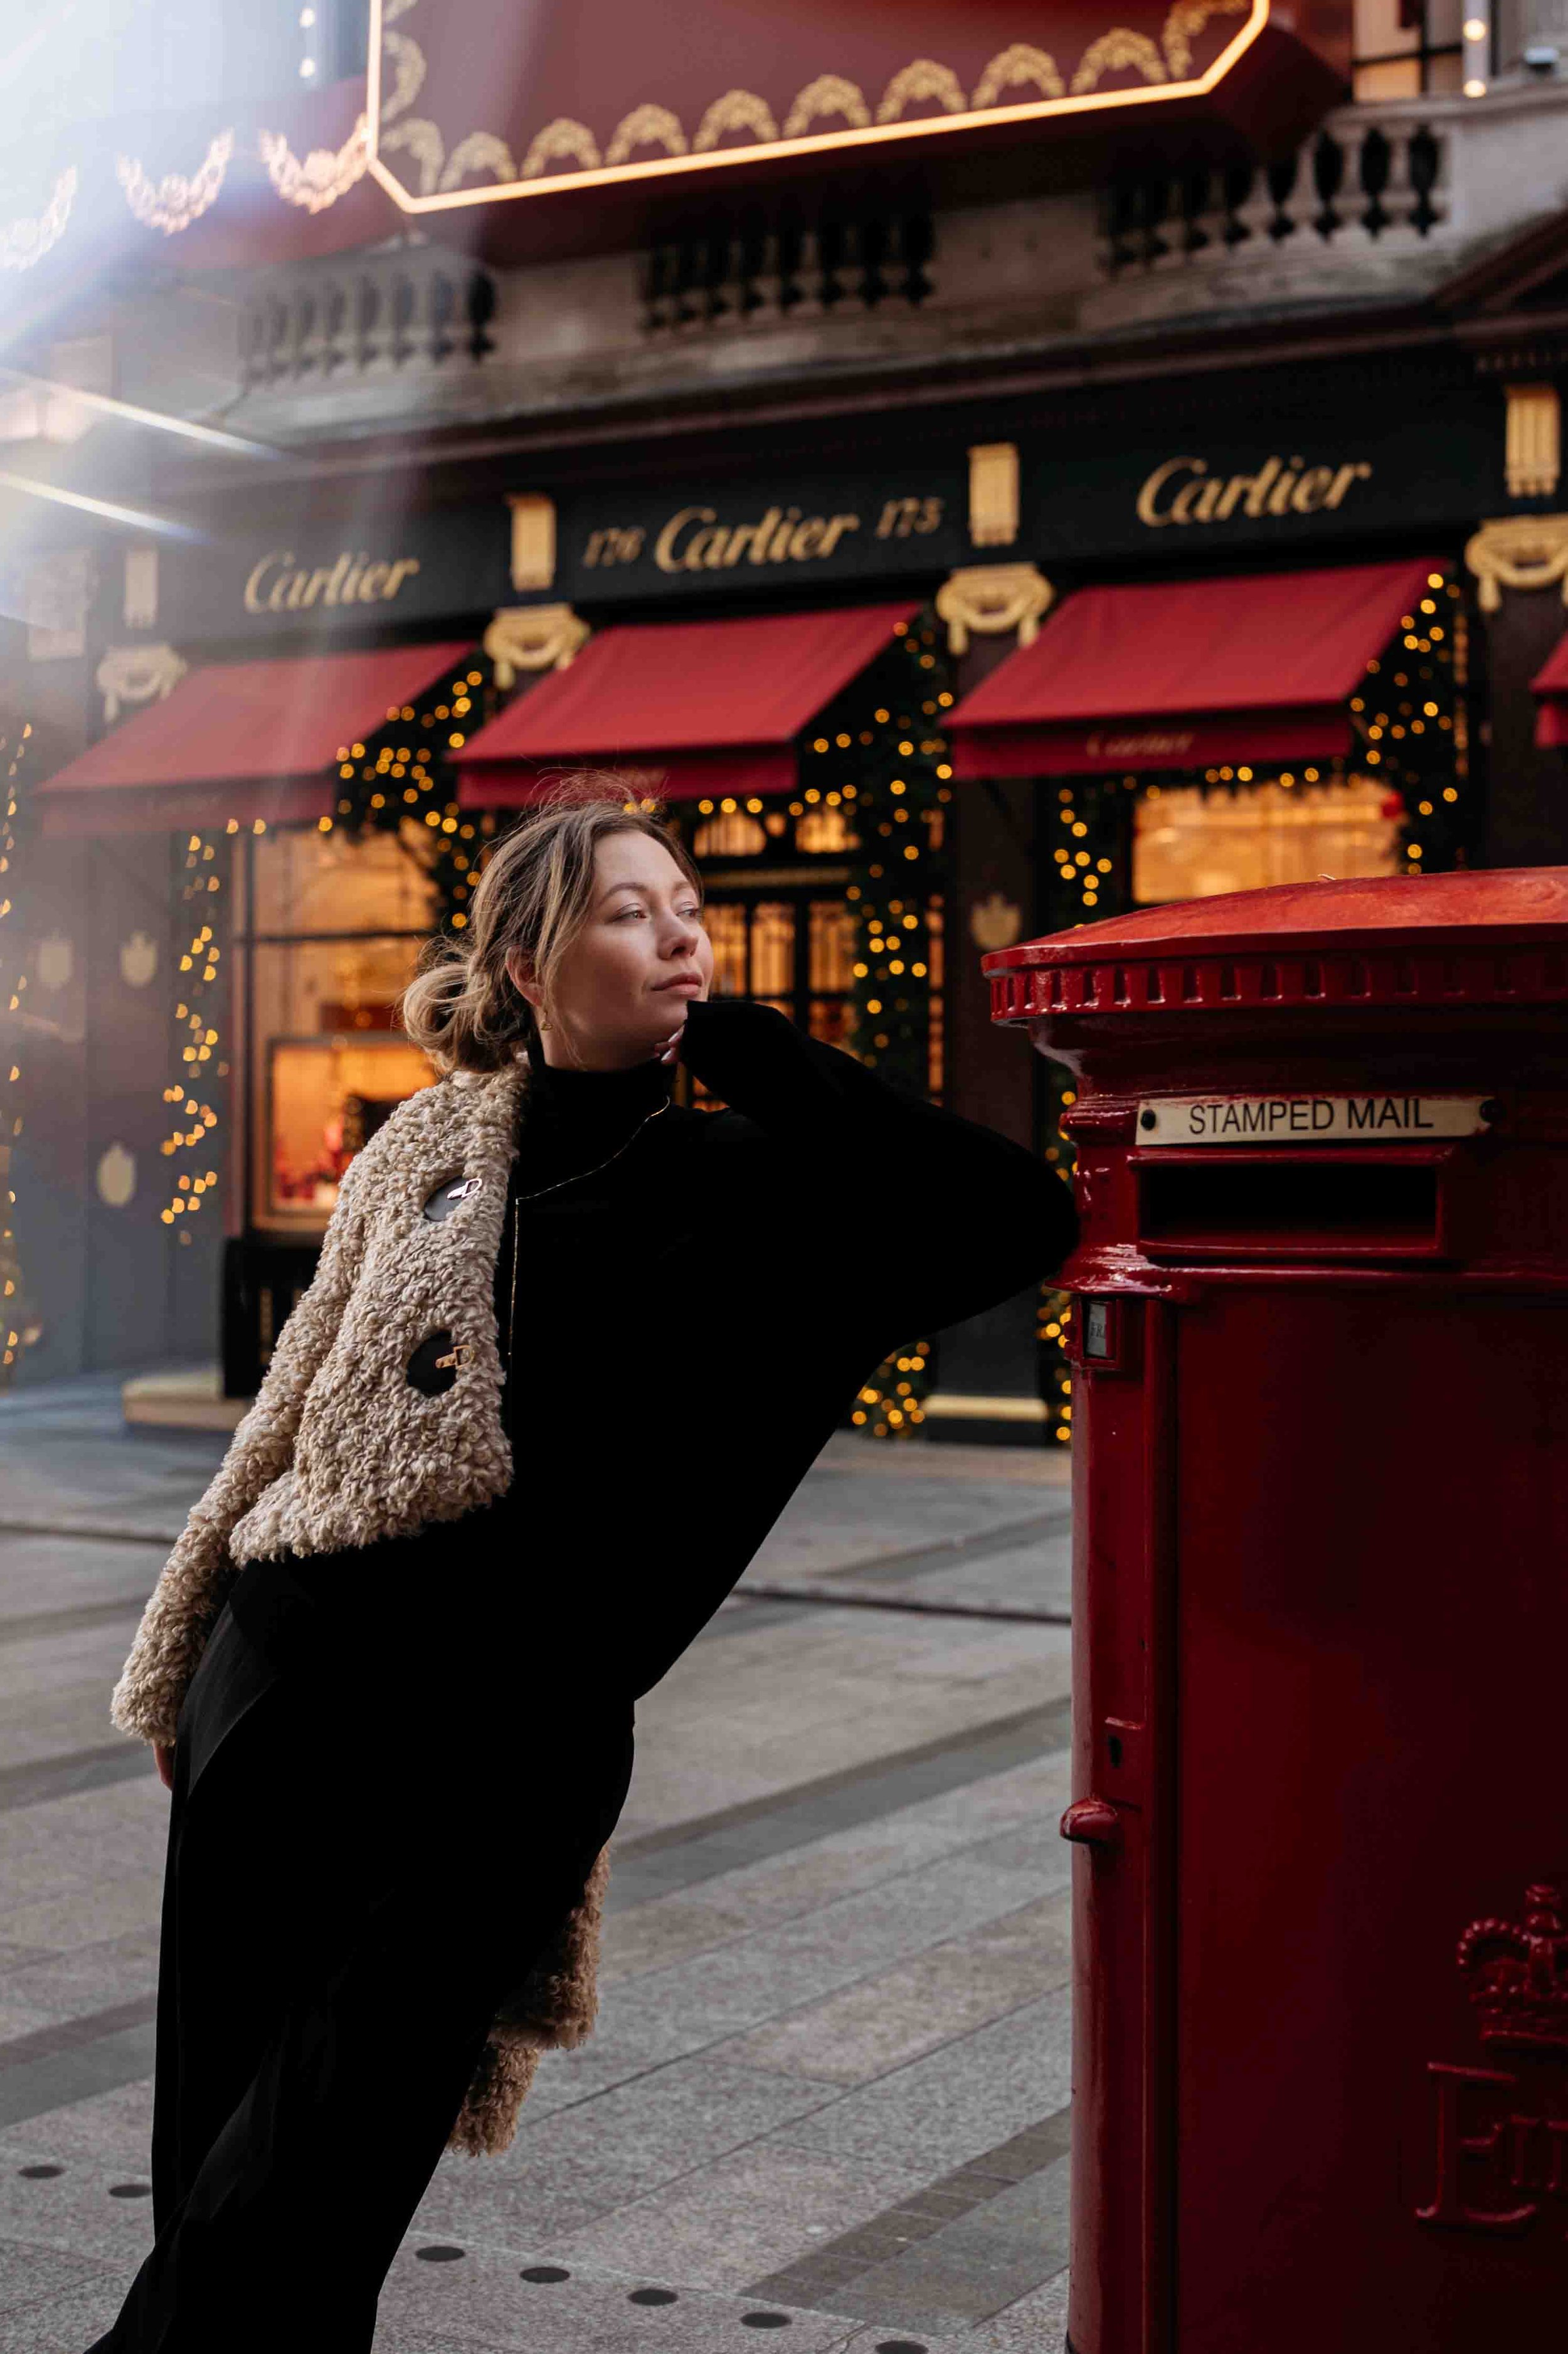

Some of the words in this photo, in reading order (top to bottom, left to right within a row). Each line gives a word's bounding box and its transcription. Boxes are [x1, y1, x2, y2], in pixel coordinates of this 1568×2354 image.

[1136, 455, 1372, 528] Cartier
[655, 507, 860, 573] Cartier
[244, 551, 420, 613] Cartier
[1189, 1100, 1335, 1135] STAMPED
[1348, 1098, 1434, 1129] MAIL
